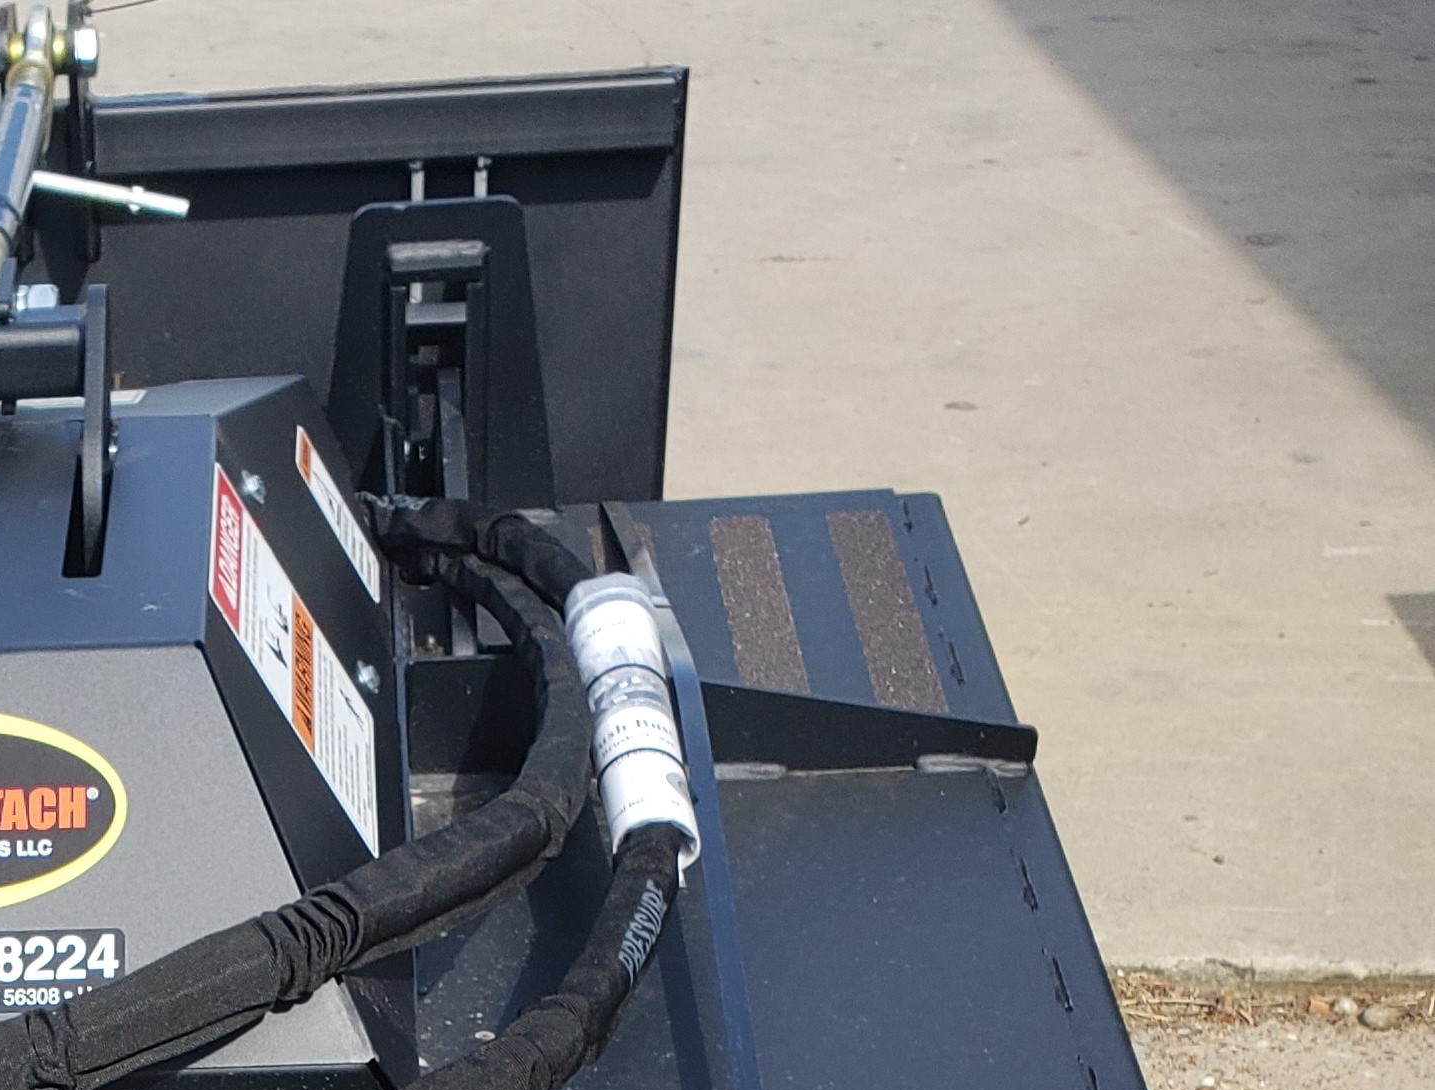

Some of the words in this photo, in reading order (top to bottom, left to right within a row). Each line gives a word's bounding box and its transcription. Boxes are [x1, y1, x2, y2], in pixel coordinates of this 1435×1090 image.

[16, 838, 53, 858] LLC
[618, 879, 668, 988] PRESSURE
[3, 987, 60, 1006] 56308
